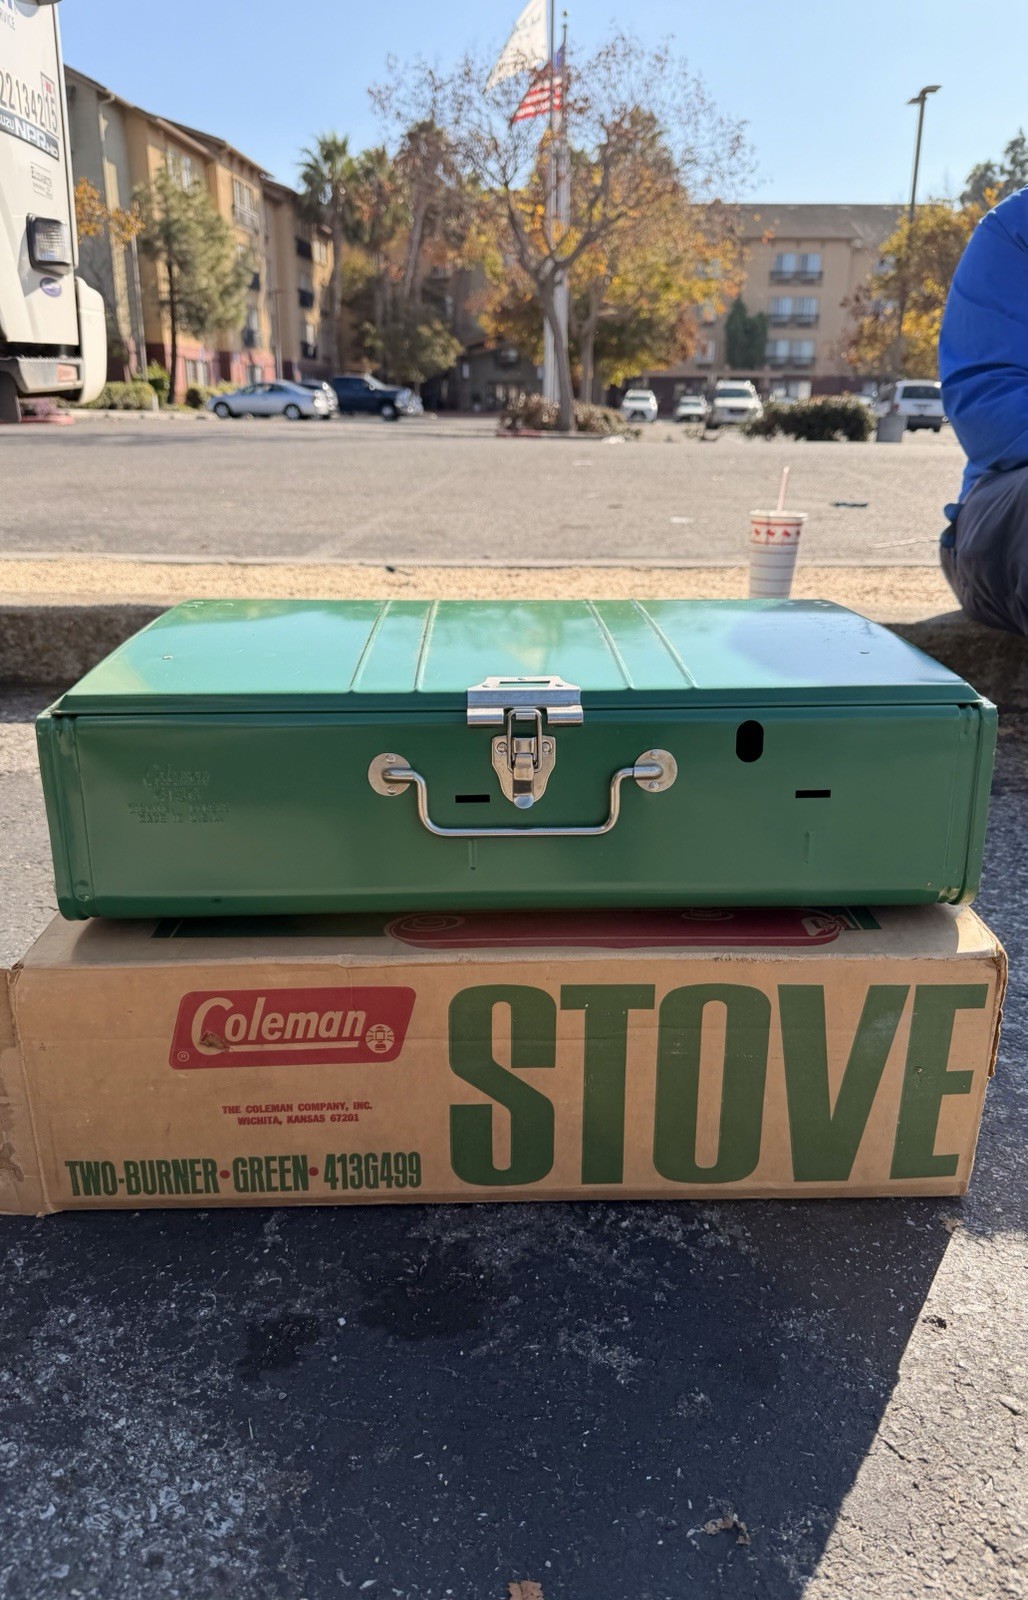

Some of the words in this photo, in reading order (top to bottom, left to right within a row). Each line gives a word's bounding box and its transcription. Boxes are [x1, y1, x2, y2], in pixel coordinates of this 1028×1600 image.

[14, 117, 47, 149] NPR
[191, 996, 366, 1055] Coleman
[448, 983, 989, 1186] STOVE
[222, 1105, 241, 1114] THE
[245, 1103, 294, 1114] COLEMAN
[297, 1101, 349, 1112] COMPANY,
[353, 1101, 373, 1110] INC.
[237, 1115, 283, 1126] WICHITA,
[286, 1114, 326, 1124] KANSAS
[330, 1113, 360, 1123] 67201
[65, 1158, 221, 1196] TWO-BURNER
[232, 1155, 310, 1193] GREEN
[323, 1152, 422, 1190] 413G499
